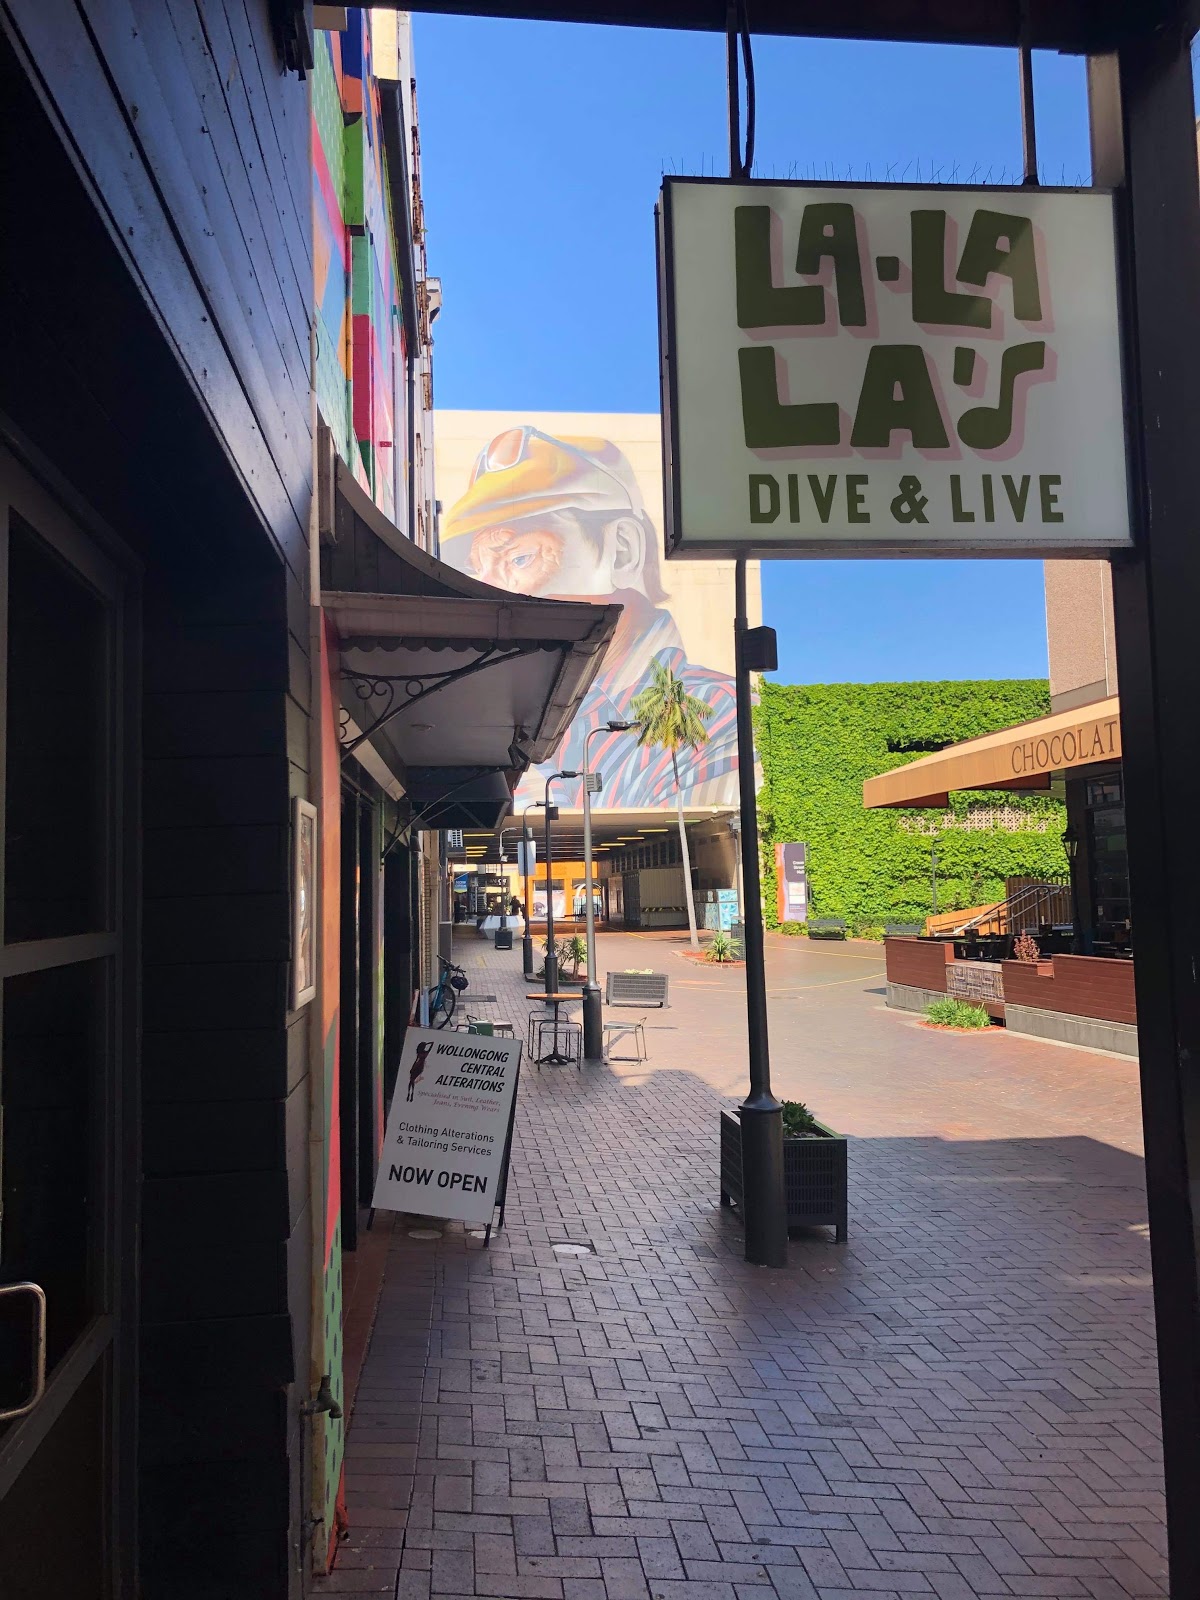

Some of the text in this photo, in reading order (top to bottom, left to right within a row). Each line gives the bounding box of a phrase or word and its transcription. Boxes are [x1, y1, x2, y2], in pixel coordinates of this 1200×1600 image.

[748, 473, 1065, 524] DIVE & LIVE
[436, 1043, 510, 1063] WOLLONGONG
[460, 1062, 506, 1078] CENTRAL
[435, 1075, 505, 1093] ALTERATIONS
[453, 1102, 479, 1112] Evening
[481, 1105, 500, 1113] Wears
[399, 1122, 495, 1143] Clothing Alterations
[396, 1135, 492, 1156] & Tailoring Services
[388, 1164, 488, 1194] NOW OPEN
